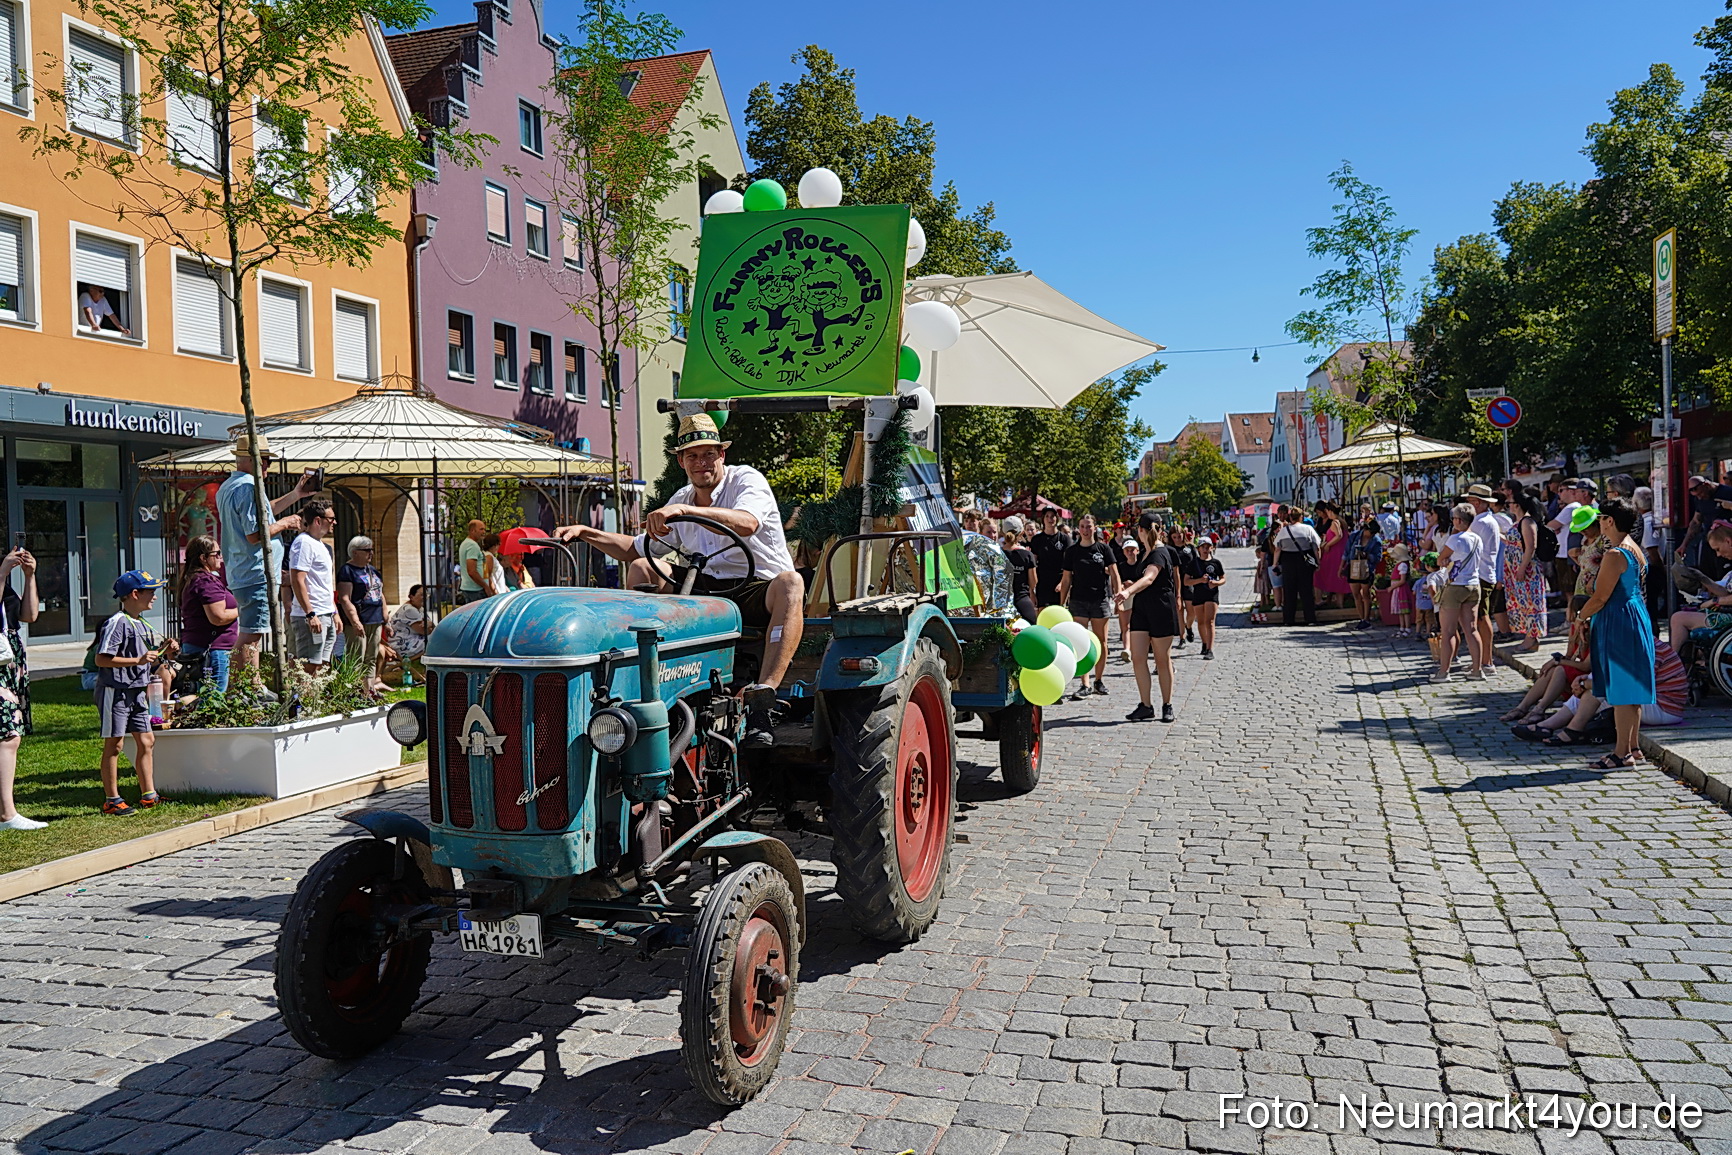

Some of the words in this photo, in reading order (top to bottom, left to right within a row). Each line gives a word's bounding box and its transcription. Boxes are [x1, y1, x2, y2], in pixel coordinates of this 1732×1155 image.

[776, 369, 806, 386] DJK
[815, 336, 867, 375] Neumarkt
[69, 399, 203, 437] hunkemöller
[658, 660, 702, 684] Hanomag
[478, 921, 502, 934] NM
